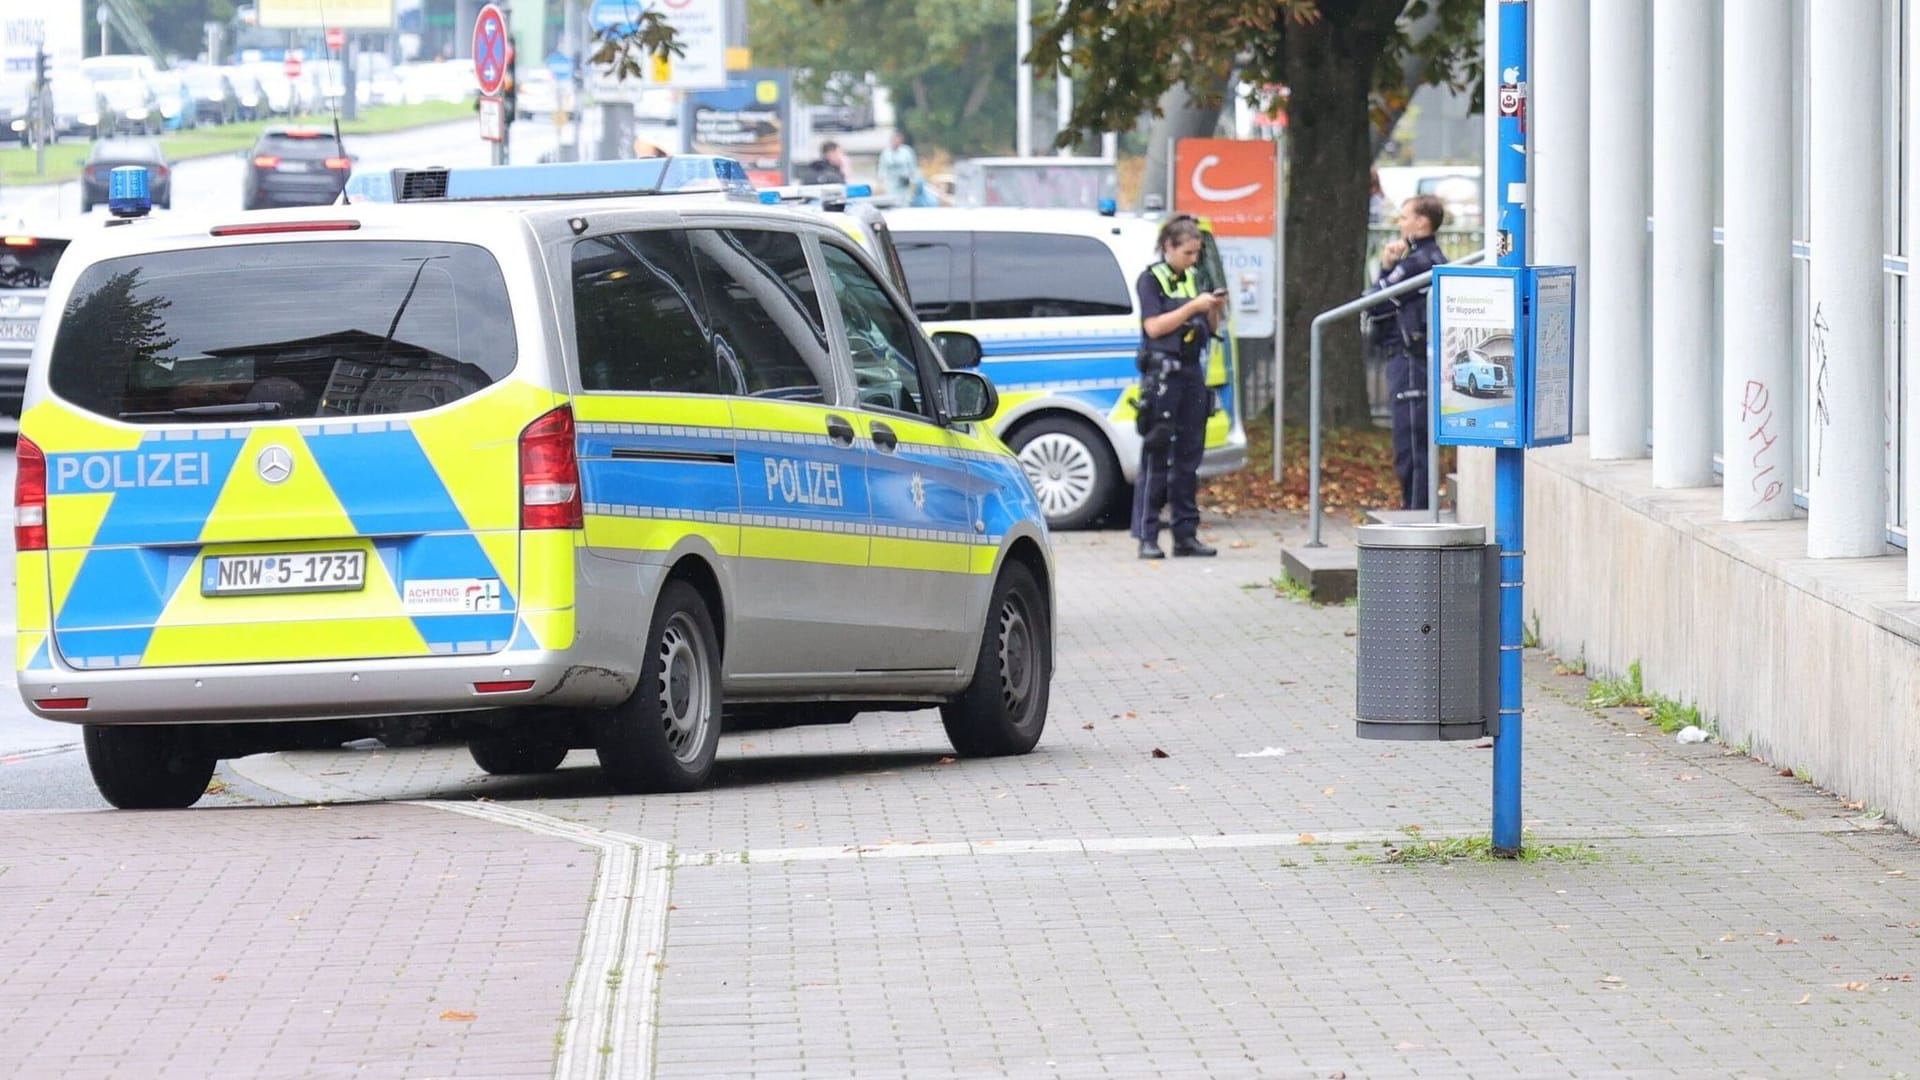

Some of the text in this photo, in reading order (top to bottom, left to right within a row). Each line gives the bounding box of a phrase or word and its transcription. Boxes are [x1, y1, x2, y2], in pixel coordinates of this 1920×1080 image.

[1456, 306, 1486, 314] Wuppertal
[57, 452, 209, 490] POLIZEI
[764, 457, 843, 507] POLIZEI
[218, 555, 360, 587] NRW 5-1731
[409, 588, 460, 598] ACHTUNG
